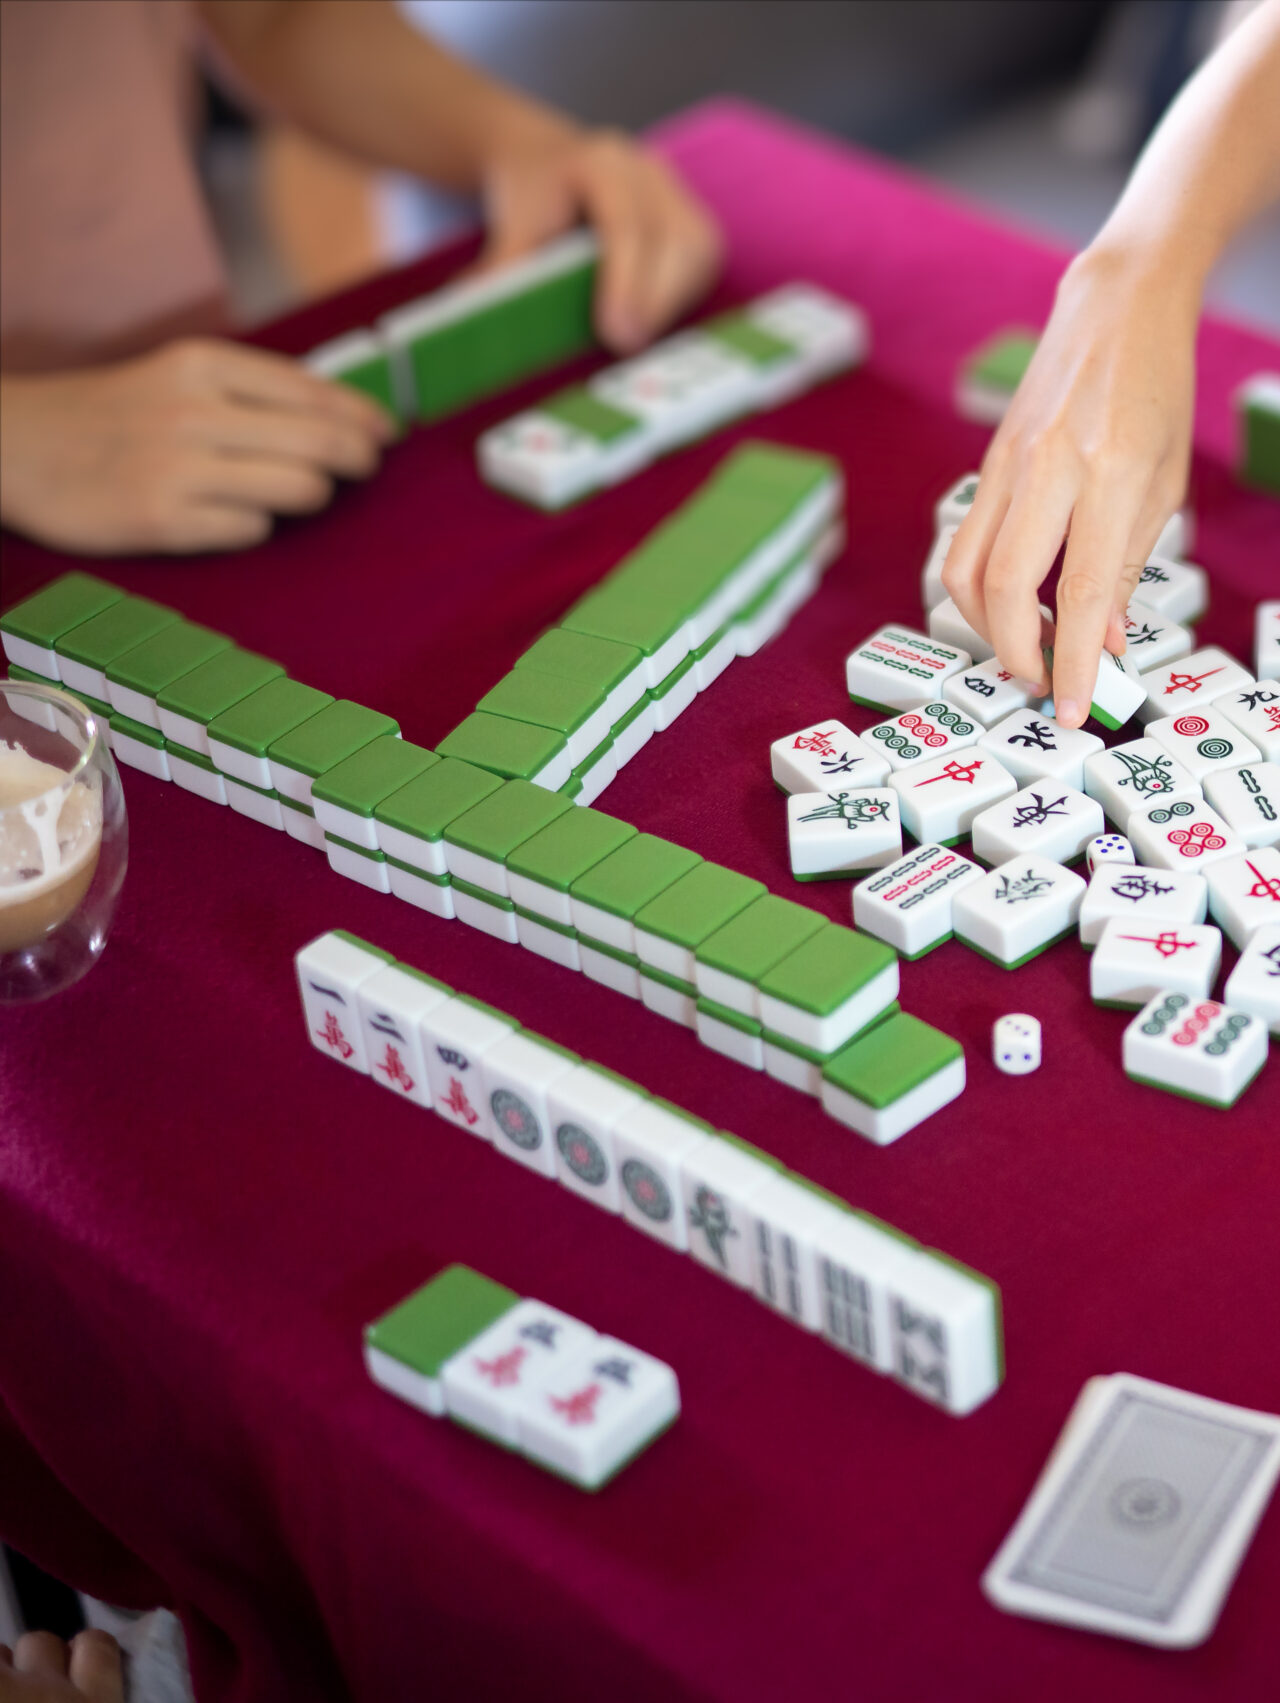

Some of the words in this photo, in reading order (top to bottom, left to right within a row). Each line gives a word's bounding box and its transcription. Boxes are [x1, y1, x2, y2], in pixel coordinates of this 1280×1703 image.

[964, 669, 1014, 698] 四
[1163, 665, 1227, 695] 中
[1007, 720, 1058, 752] 北
[792, 731, 865, 774] 六萬
[914, 760, 984, 787] 中
[1012, 792, 1070, 828] 東
[1111, 875, 1175, 902] 南
[1117, 932, 1198, 958] 中
[310, 981, 354, 1060] 一萬
[369, 1012, 414, 1092] 二萬
[435, 1044, 479, 1126] 四萬
